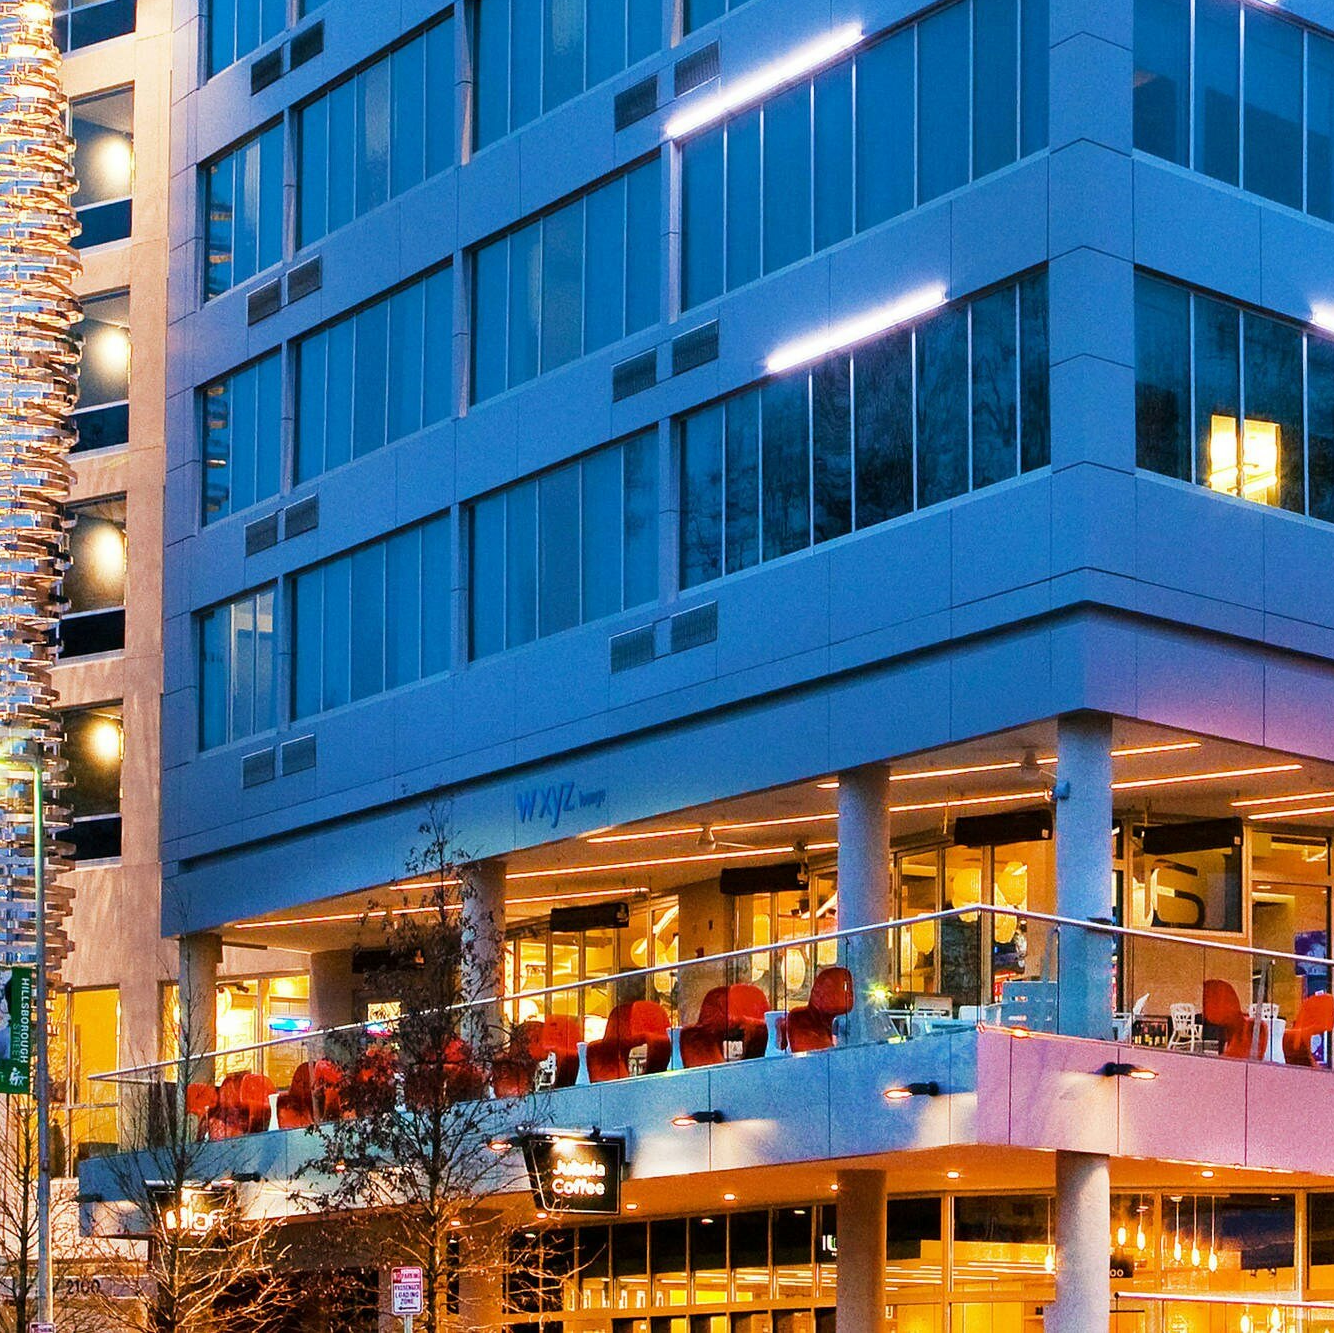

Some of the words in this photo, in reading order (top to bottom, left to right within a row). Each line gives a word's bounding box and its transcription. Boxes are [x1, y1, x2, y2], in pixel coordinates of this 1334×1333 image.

[20, 977, 30, 1064] HILLSBOROUGH
[552, 1178, 605, 1196] Coffee
[67, 1279, 101, 1294] 2100
